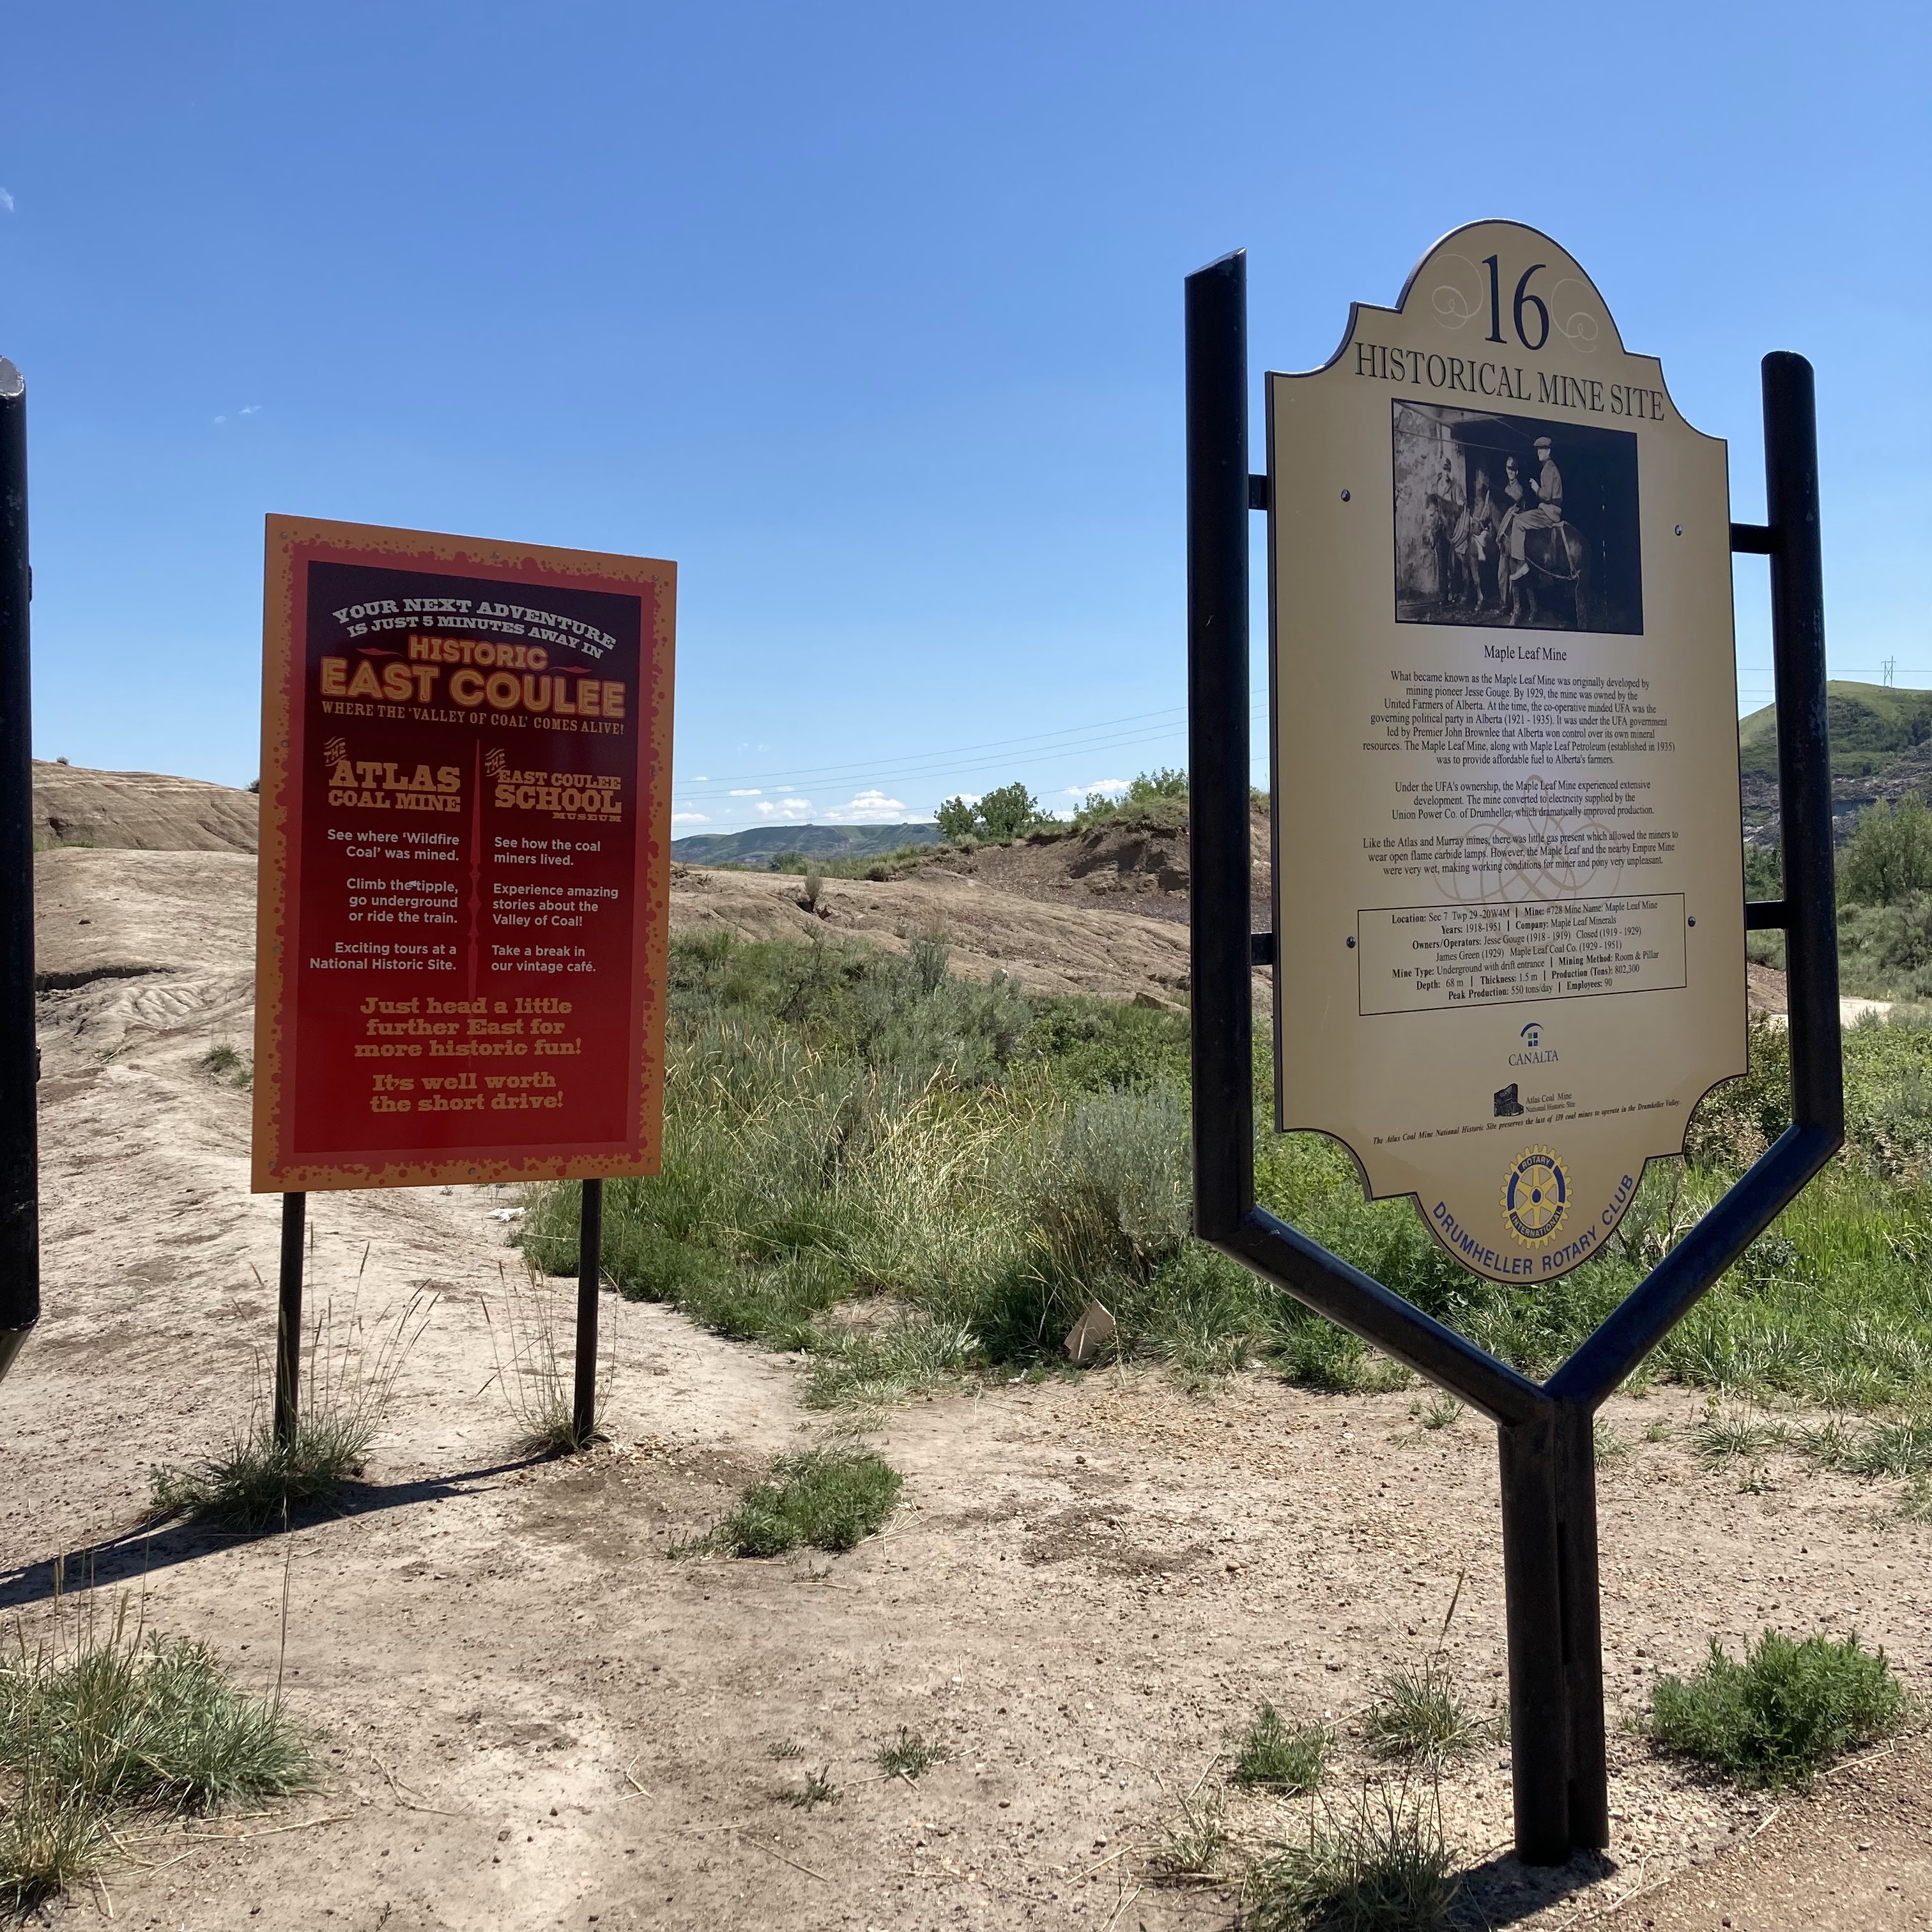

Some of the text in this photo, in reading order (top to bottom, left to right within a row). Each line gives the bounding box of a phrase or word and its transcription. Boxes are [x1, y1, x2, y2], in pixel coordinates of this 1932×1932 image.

[1482, 254, 1550, 351] 16
[1354, 342, 1664, 421] HISTORICAL MINE SITE
[332, 599, 617, 650] YOUR NEXT ADVENTURE
[347, 616, 604, 659] IS JUST 5 MINUTES AWAY IN
[408, 635, 548, 670] HISTORIC
[1484, 645, 1567, 661] Maple Leaf Mine
[321, 656, 625, 718] EAST COULEE
[1390, 671, 1411, 682] What
[1413, 671, 1443, 683] became
[1445, 671, 1469, 684] known
[1471, 675, 1479, 684] as
[1481, 673, 1492, 684] the
[1494, 673, 1517, 686] Maple
[1519, 674, 1536, 684] Leaf
[1537, 675, 1556, 686] Mine
[1572, 677, 1605, 689] originally
[1606, 678, 1639, 689] developed
[1641, 678, 1650, 689] by
[322, 701, 373, 717] WHERE
[378, 707, 405, 719] THE
[470, 713, 487, 724] OF
[533, 717, 578, 732] COMES
[581, 721, 624, 735] ALIVE!
[324, 742, 346, 763] THE
[1436, 753, 1615, 767] was to provide affordable fuel to Alberta's farmers.
[485, 753, 505, 773] THE
[328, 760, 461, 793] ATLAS
[498, 769, 621, 790] EAST COULEE
[1395, 779, 1651, 794] Under the UFA's ownership, the Maple Leaf Mine experienced extensive
[328, 790, 461, 812] COAL MINE
[495, 784, 622, 813] SCHOOL
[553, 812, 622, 822] MUSEUM
[327, 829, 353, 841] See
[356, 831, 398, 843] where
[494, 837, 601, 852] See how the coal
[385, 848, 411, 859] was
[414, 848, 459, 861] mined.
[494, 853, 574, 866] miners lived.
[346, 878, 458, 894] Climb the tipple,
[493, 883, 618, 900] Experience amazing
[349, 895, 458, 908] go underground
[493, 899, 599, 912] stories about the
[349, 910, 457, 923] or ride the train.
[493, 914, 583, 927] Valley of Coal!
[1441, 916, 1616, 934] Years: 1918-1951 Company: Maple Leaf Minerals
[335, 942, 457, 957] Exciting tours at a
[492, 946, 585, 957] Take a break in
[310, 958, 456, 970] National Historic Site.
[491, 961, 597, 974] our vintage café.
[1448, 978, 1612, 1000] Peak Production: 550 tons/day Employees: 90
[360, 997, 572, 1015] Just head a little
[366, 1019, 565, 1036] further East for
[355, 1038, 582, 1057] more historic fun!
[1508, 1049, 1559, 1067] CANALTA
[421, 1073, 478, 1090] well
[484, 1071, 556, 1088] worth
[370, 1091, 564, 1112] the short drive!
[1542, 1093, 1554, 1102] Coal
[1558, 1092, 1572, 1101] Mine
[1526, 1104, 1545, 1113] National
[1522, 1156, 1550, 1169] ROTARY
[1432, 1174, 1633, 1275] DRUMHELLER ROTARY CLUB
[1511, 1210, 1561, 1238] INTERNATIONAL
